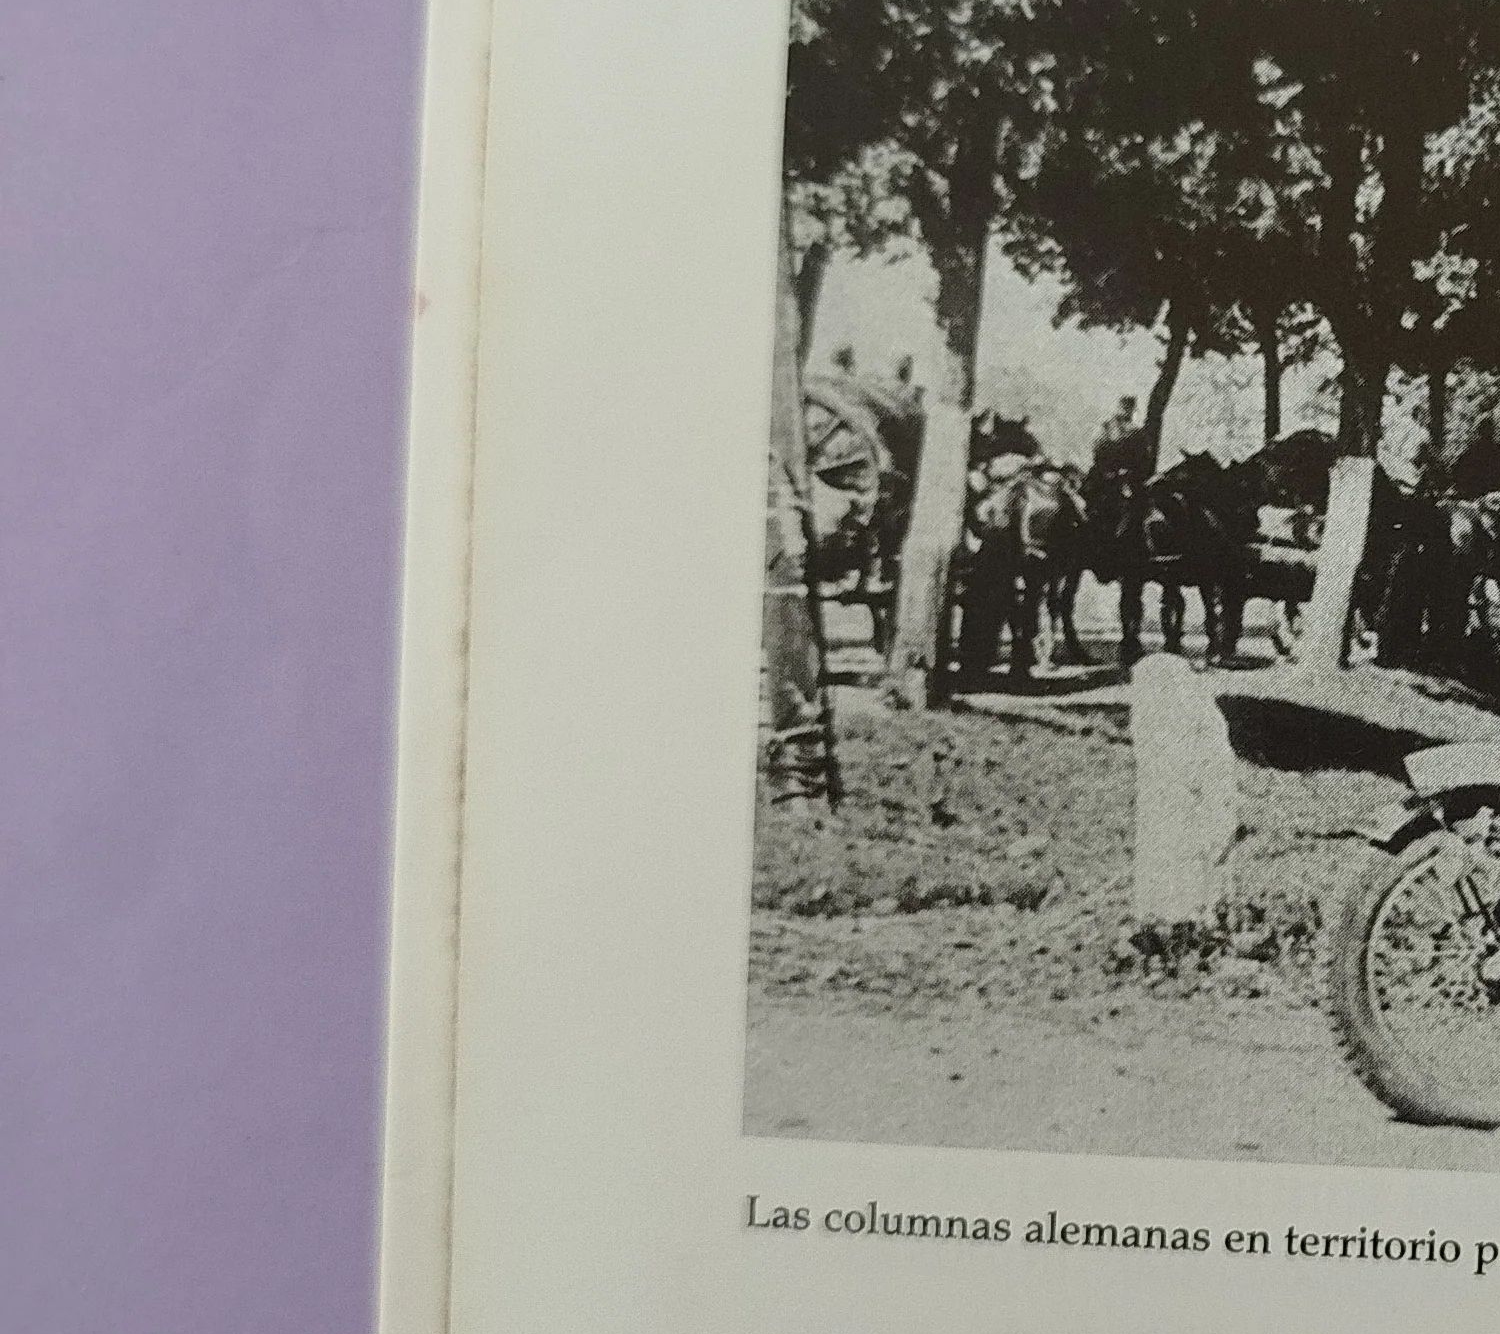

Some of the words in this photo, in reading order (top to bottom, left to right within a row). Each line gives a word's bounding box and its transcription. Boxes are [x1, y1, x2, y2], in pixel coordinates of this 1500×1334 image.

[746, 1195, 810, 1231] Las
[824, 1201, 1011, 1242] columnas
[1025, 1211, 1210, 1251] alemanas
[1225, 1230, 1271, 1254] en
[1285, 1226, 1461, 1263] territorio
